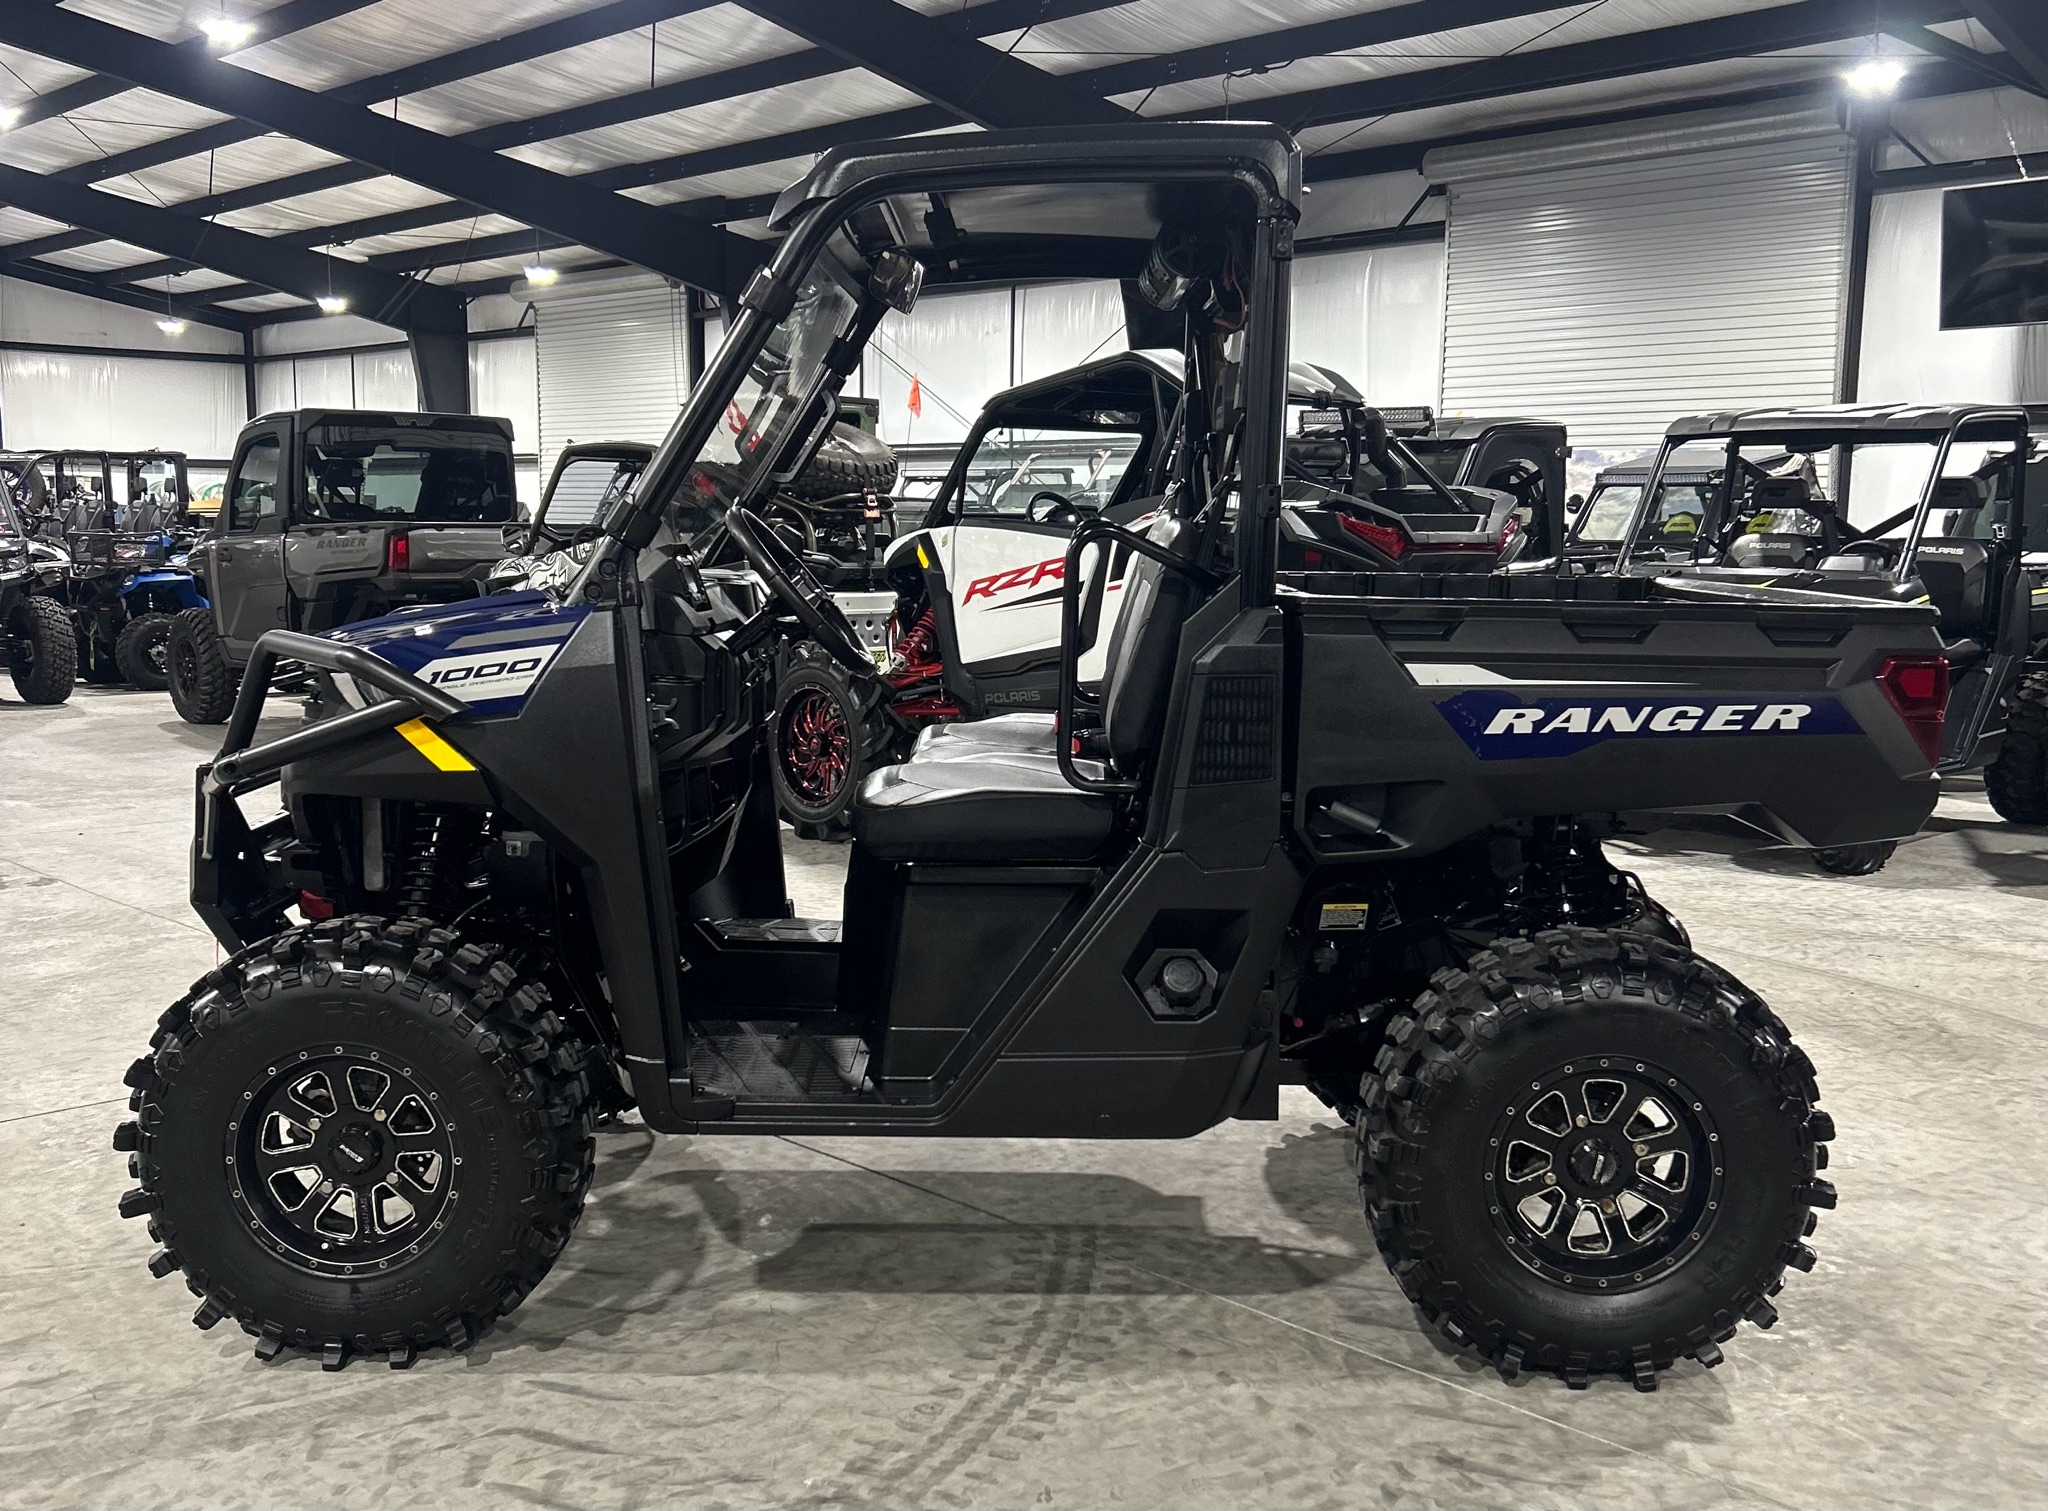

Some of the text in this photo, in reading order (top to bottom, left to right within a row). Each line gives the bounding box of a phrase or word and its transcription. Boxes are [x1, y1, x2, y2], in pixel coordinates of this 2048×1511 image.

[317, 537, 367, 549] RANGER
[1917, 545, 1964, 555] POLARIS
[962, 556, 1067, 607] RZR
[429, 657, 542, 685] 1000
[439, 682, 467, 690] INGLE
[984, 690, 1041, 704] POLARIS
[1483, 704, 1812, 735] RANGER
